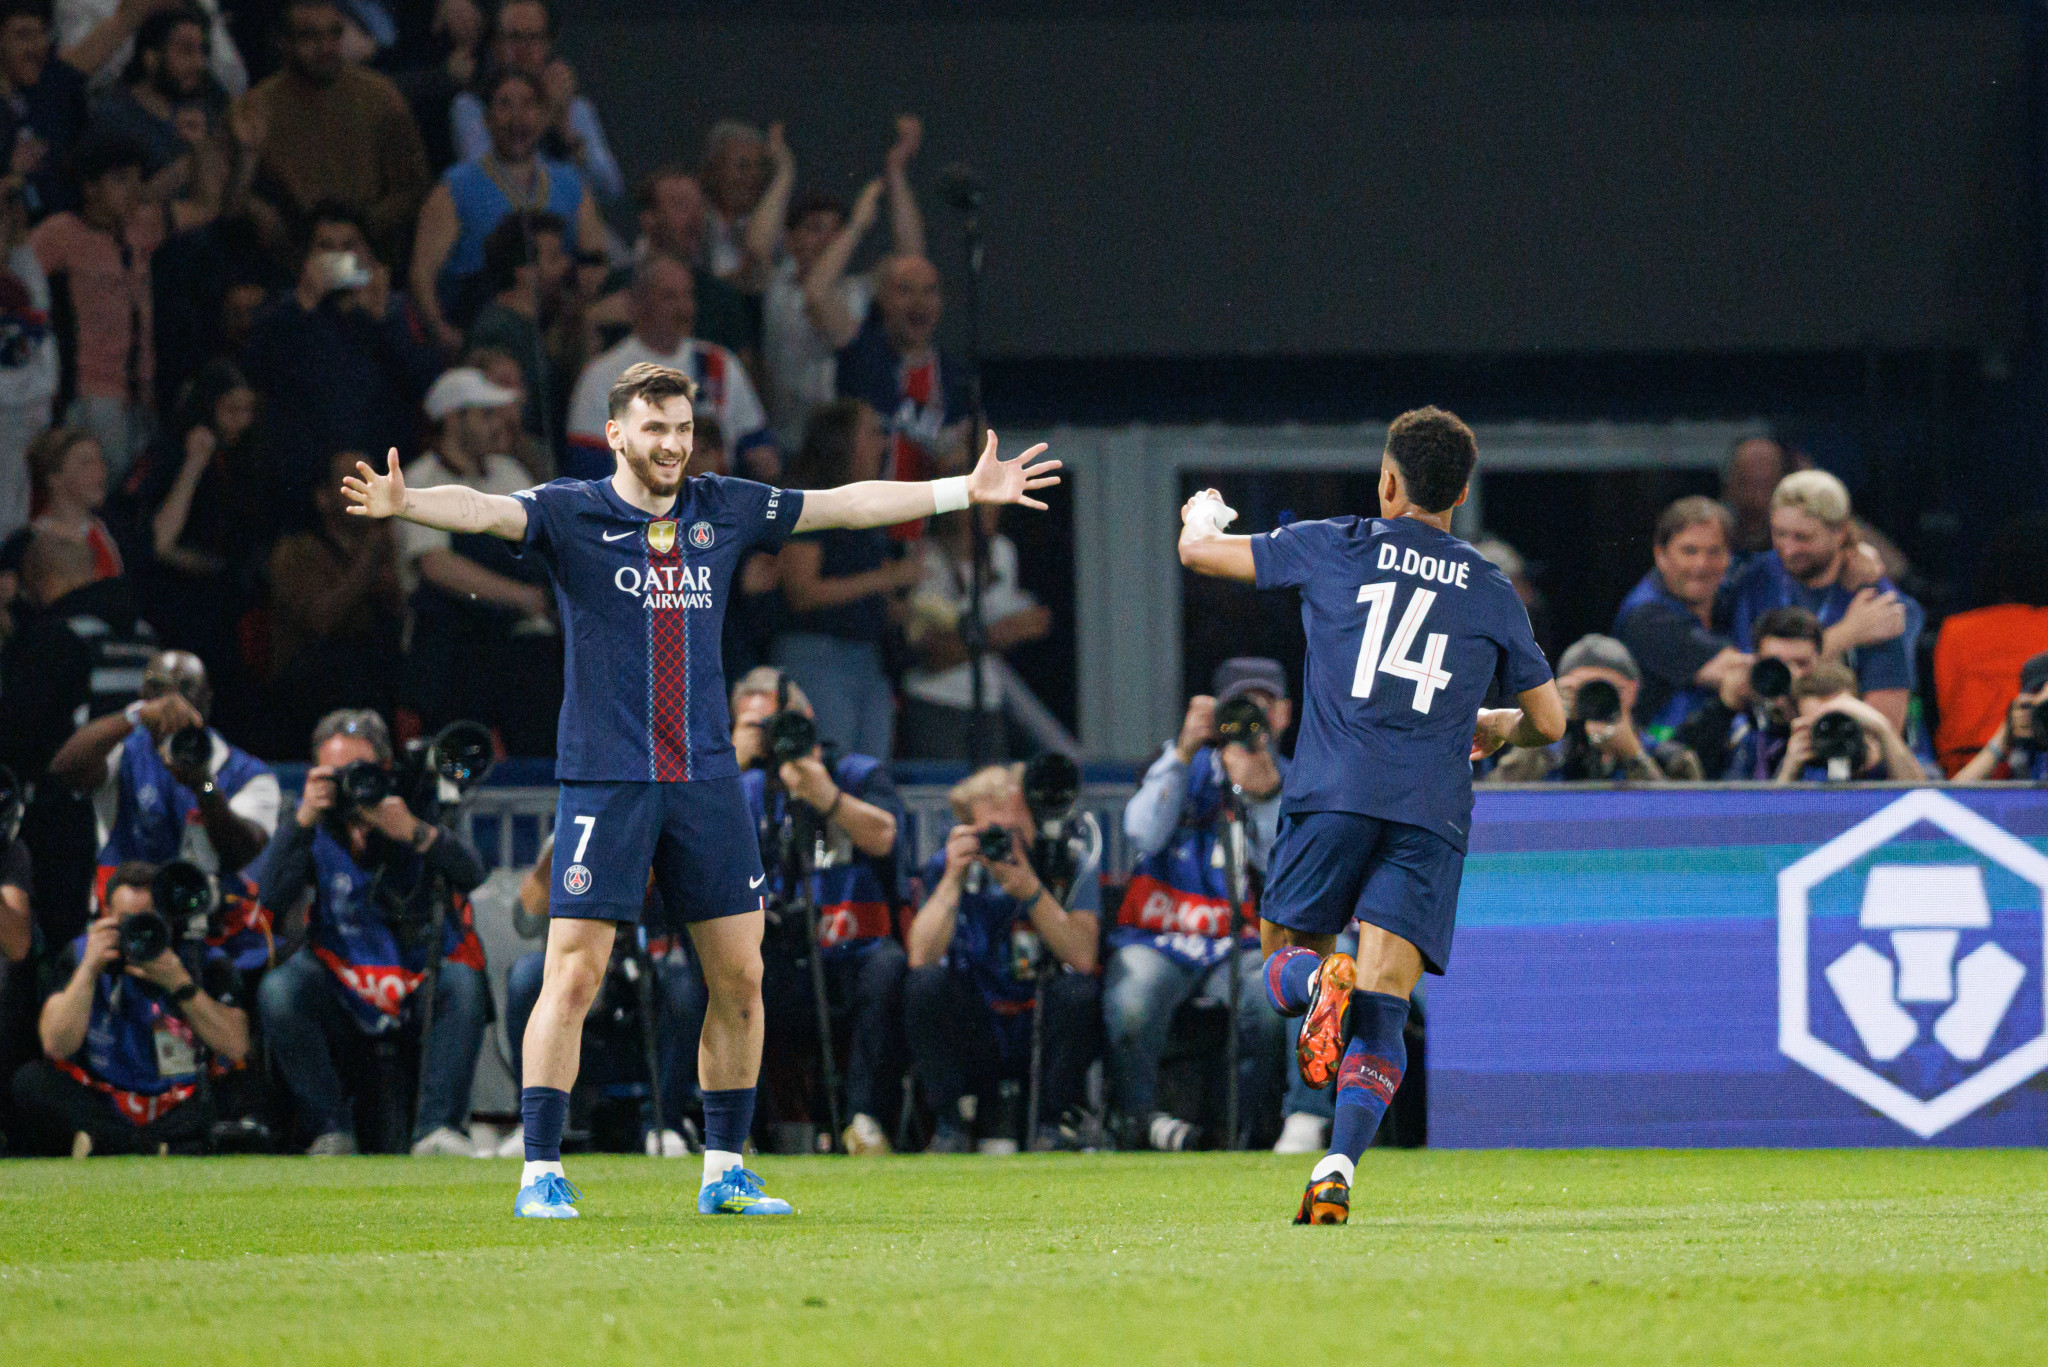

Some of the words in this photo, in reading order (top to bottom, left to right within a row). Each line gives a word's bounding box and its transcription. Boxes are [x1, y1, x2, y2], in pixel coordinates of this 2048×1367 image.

[614, 566, 712, 597] QATAR
[1377, 542, 1470, 590] D.DOUÉ
[642, 593, 713, 609] AIRWAYS
[1351, 581, 1453, 715] 14
[573, 815, 596, 863] 7
